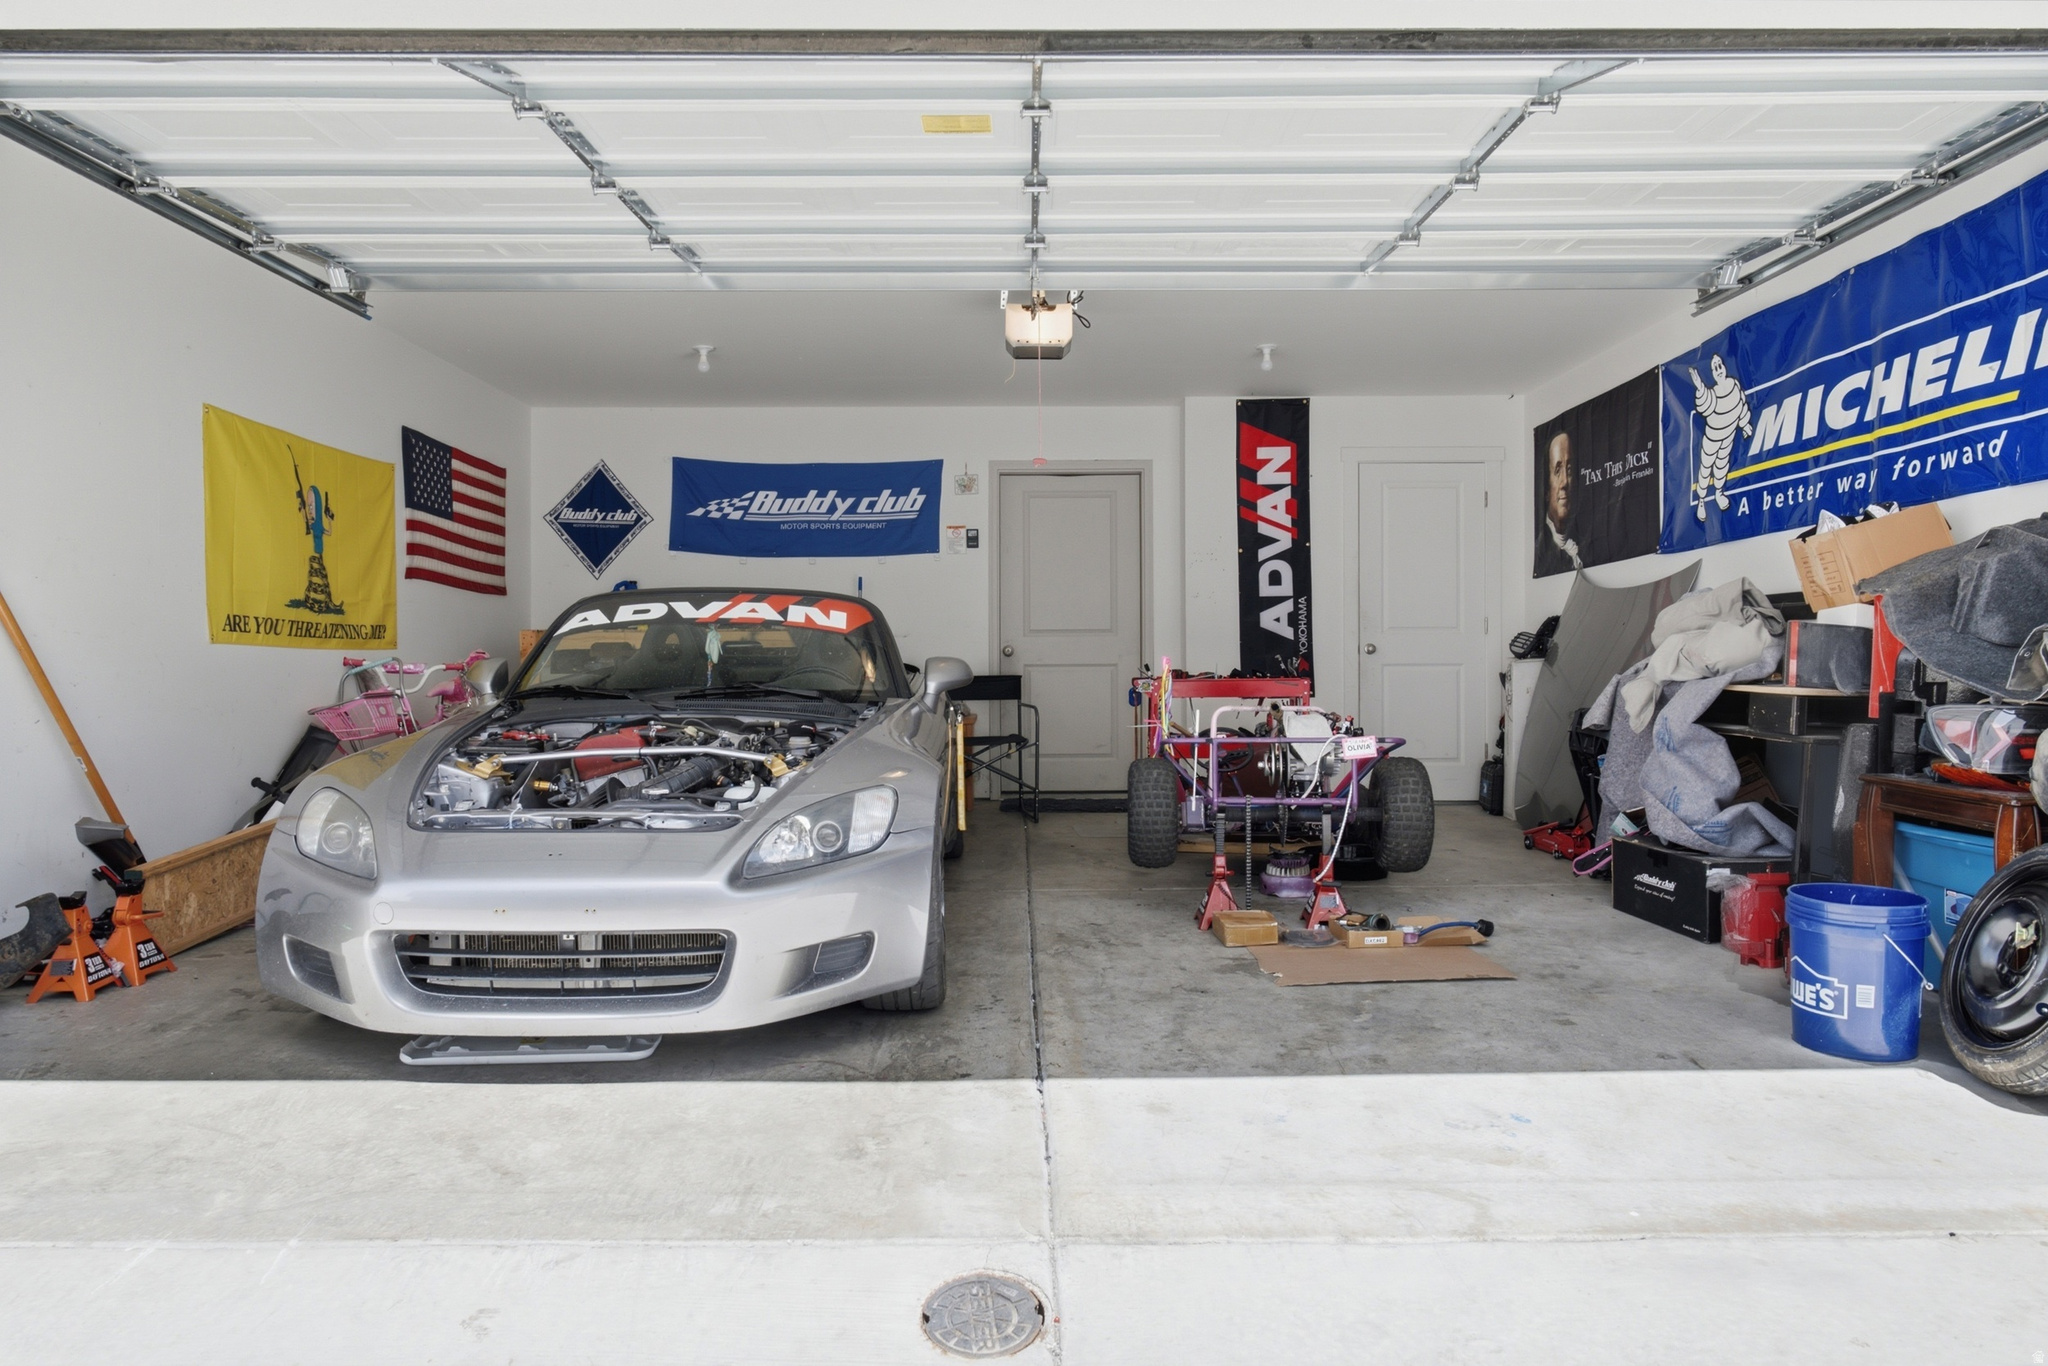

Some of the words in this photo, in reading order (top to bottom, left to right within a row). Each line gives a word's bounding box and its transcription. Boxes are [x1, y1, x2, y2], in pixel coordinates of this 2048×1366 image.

[1748, 308, 2048, 457] MICHELI
[1737, 497, 1750, 517] A
[1762, 481, 1824, 511] better
[1836, 469, 1878, 494] way
[1891, 430, 2008, 481] forward
[558, 507, 606, 523] Buddy
[606, 509, 638, 522] club
[749, 489, 856, 521] Buddy
[856, 487, 927, 514] club
[780, 523, 809, 531] MOTOR
[810, 522, 841, 530] SPORTS
[842, 522, 887, 530] EQUIPMENT
[1256, 446, 1295, 641] ADVAN
[222, 613, 251, 633] ARE
[253, 616, 285, 636] YOU
[287, 620, 369, 640] THREATENING
[368, 624, 387, 640] ME?
[553, 601, 847, 636] ADVAN
[1298, 595, 1308, 655] YOKOHAMA
[1347, 743, 1372, 752] OLIVIA
[84, 957, 96, 974] 3
[136, 943, 148, 959] 3
[1791, 977, 1835, 1011] WE'S
